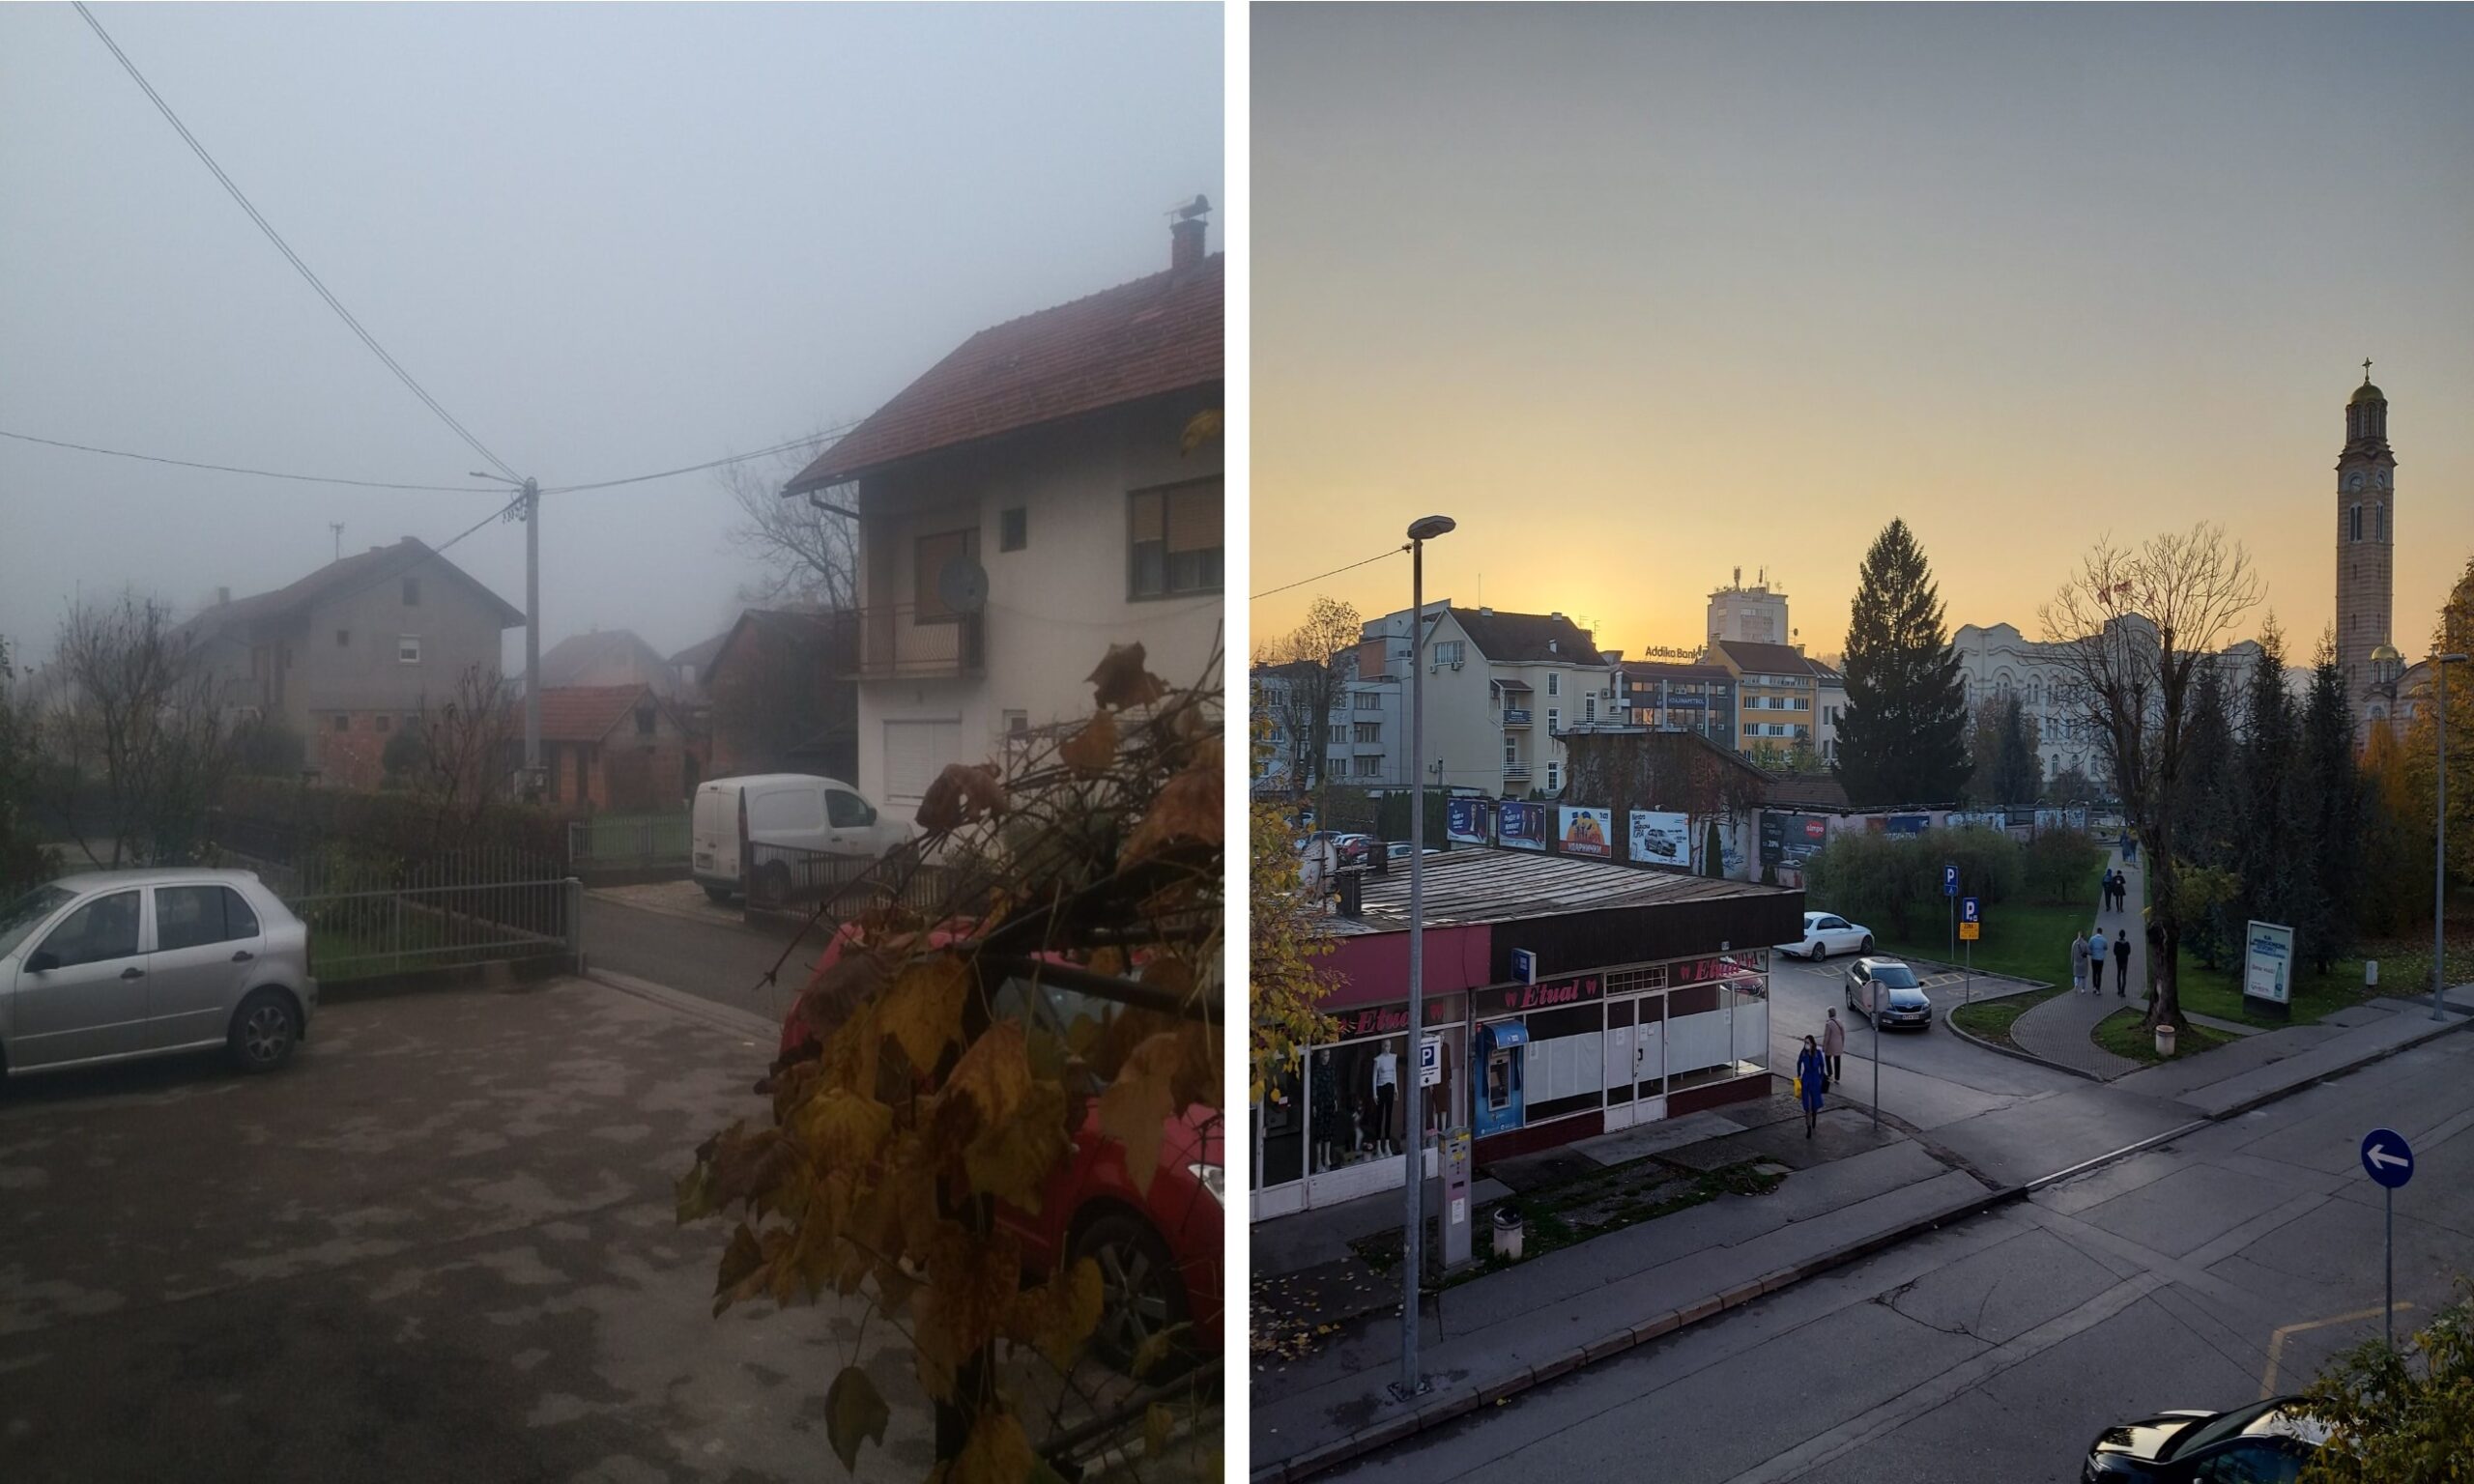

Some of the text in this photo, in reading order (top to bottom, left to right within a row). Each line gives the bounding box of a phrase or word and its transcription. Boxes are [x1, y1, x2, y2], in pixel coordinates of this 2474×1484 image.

[1645, 645, 1698, 659] Addiko Bank
[1806, 823, 1825, 834] simpo
[1947, 868, 1955, 883] P
[1966, 900, 1975, 920] P
[1519, 979, 1580, 1009] Etual
[1355, 1007, 1410, 1035] Etua
[1422, 1047, 1432, 1067] P
